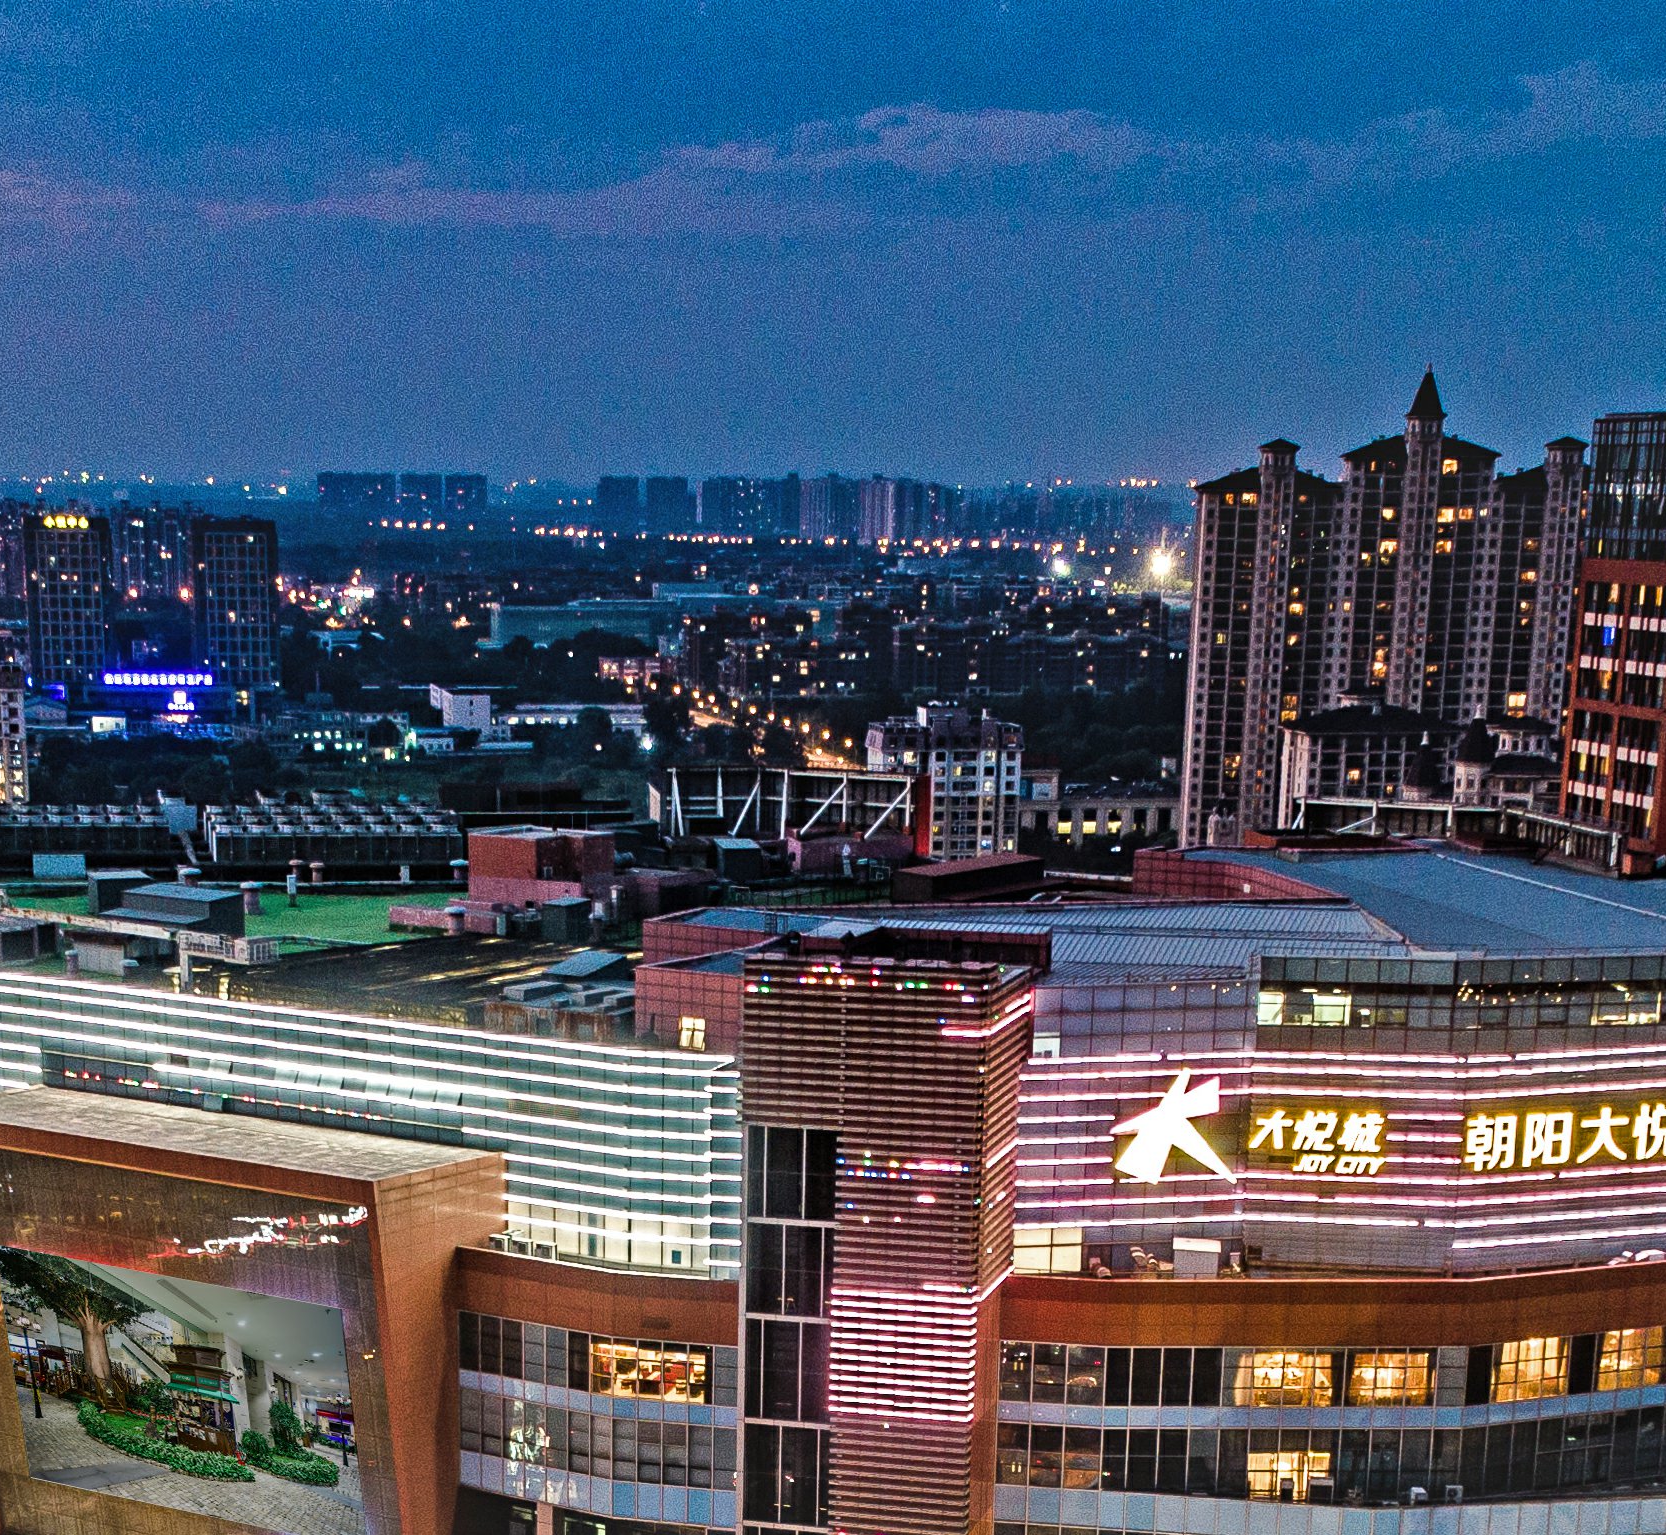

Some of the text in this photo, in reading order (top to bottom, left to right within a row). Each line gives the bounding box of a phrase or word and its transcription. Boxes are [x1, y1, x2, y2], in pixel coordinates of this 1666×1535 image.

[1248, 1111, 1384, 1152] 大悦城
[1292, 1154, 1384, 1174] JOY CITY
